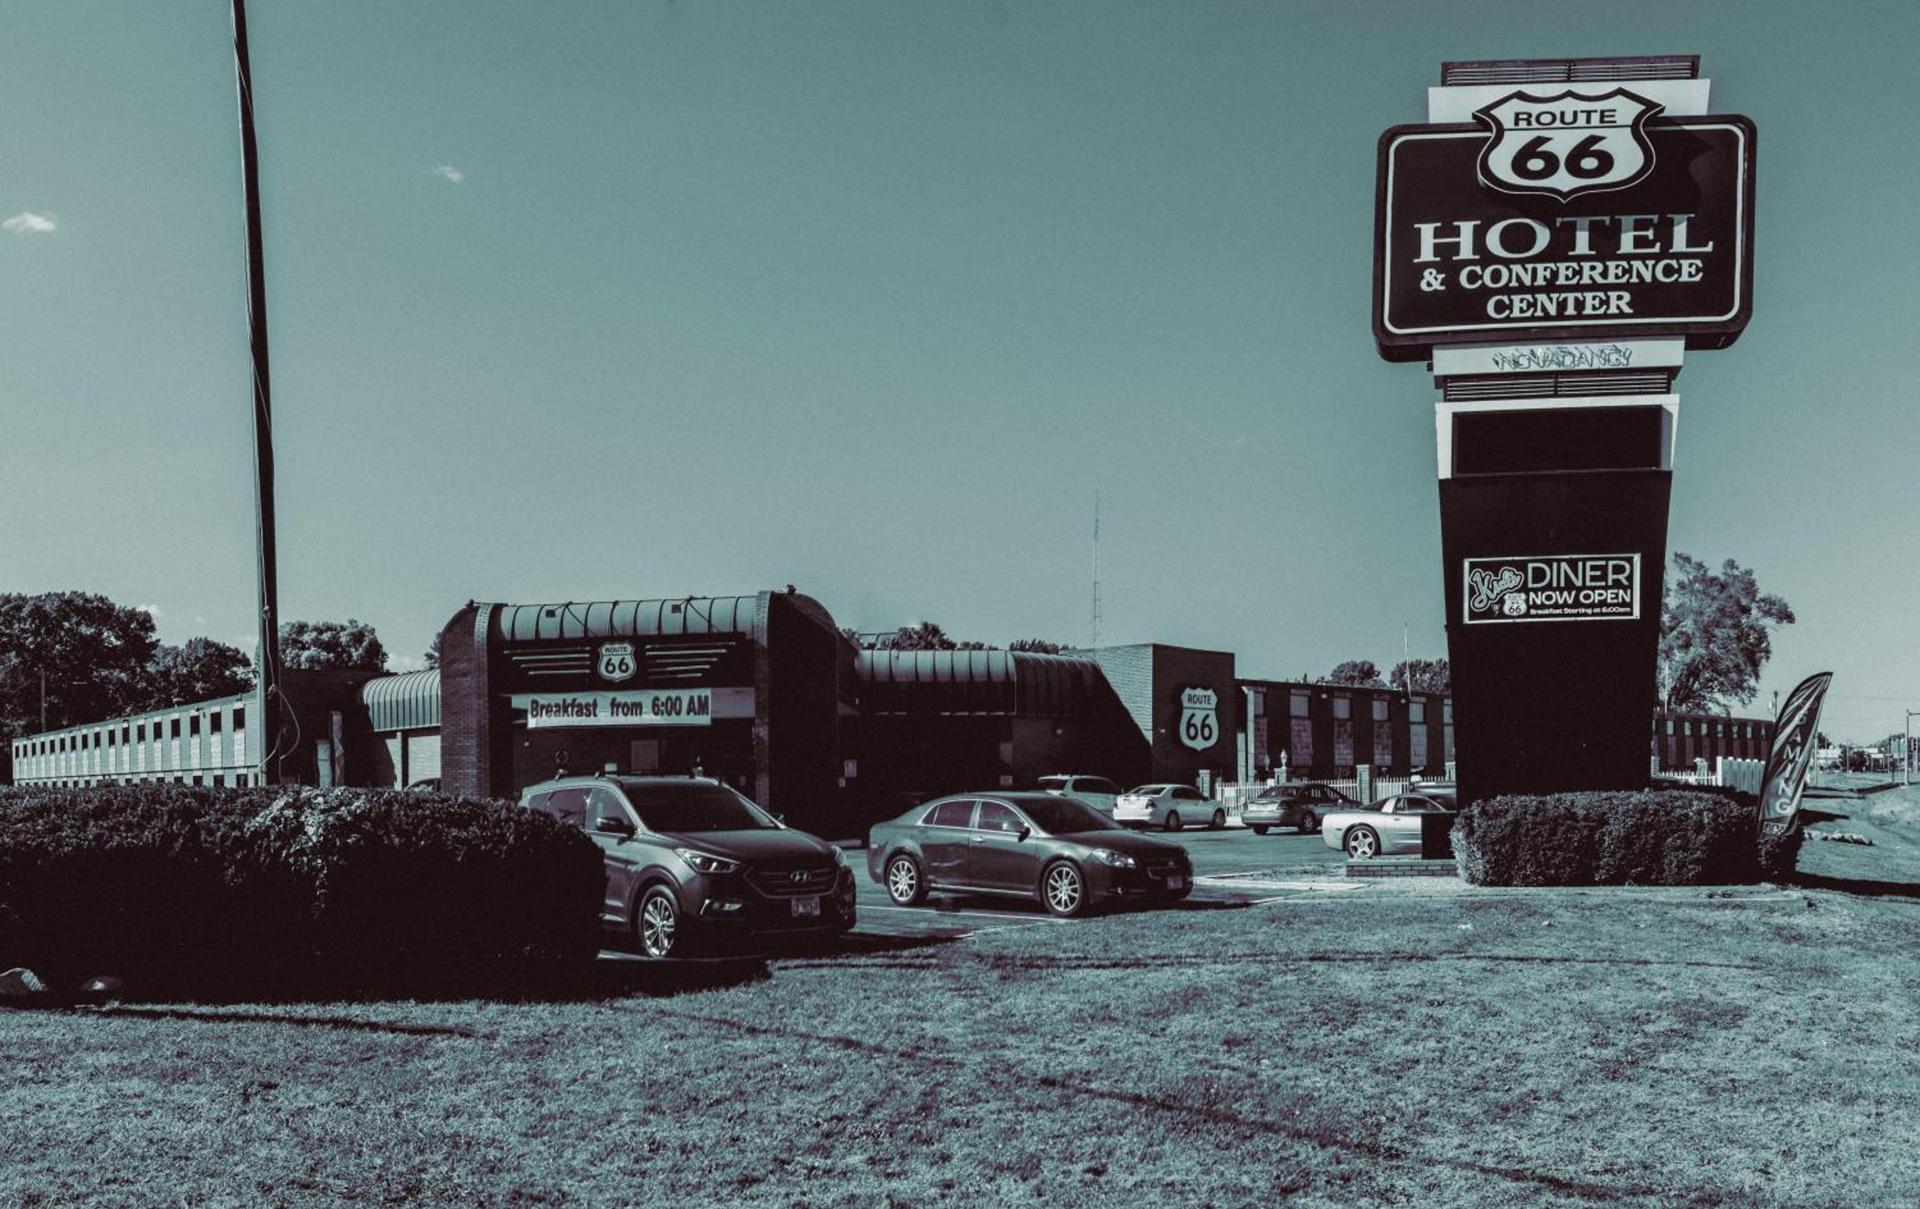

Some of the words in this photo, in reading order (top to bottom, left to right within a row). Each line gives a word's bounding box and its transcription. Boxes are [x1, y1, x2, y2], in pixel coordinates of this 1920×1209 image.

[1513, 108, 1617, 127] ROUTE
[1511, 134, 1615, 181] 66
[1413, 213, 1714, 263] HOTEL
[1420, 268, 1446, 292] &
[1459, 259, 1704, 289] CONFERENCE
[1486, 291, 1634, 319] CENTER
[1527, 560, 1631, 588] DINER
[1529, 590, 1577, 605] NOW
[1579, 588, 1631, 604] OPEN
[605, 656, 629, 674] 66
[530, 698, 598, 718] Breakfast
[610, 697, 643, 717] from
[651, 696, 682, 716] 6:00
[686, 695, 710, 716] AM
[1187, 694, 1212, 705] ROUTE
[1186, 712, 1213, 741] 66
